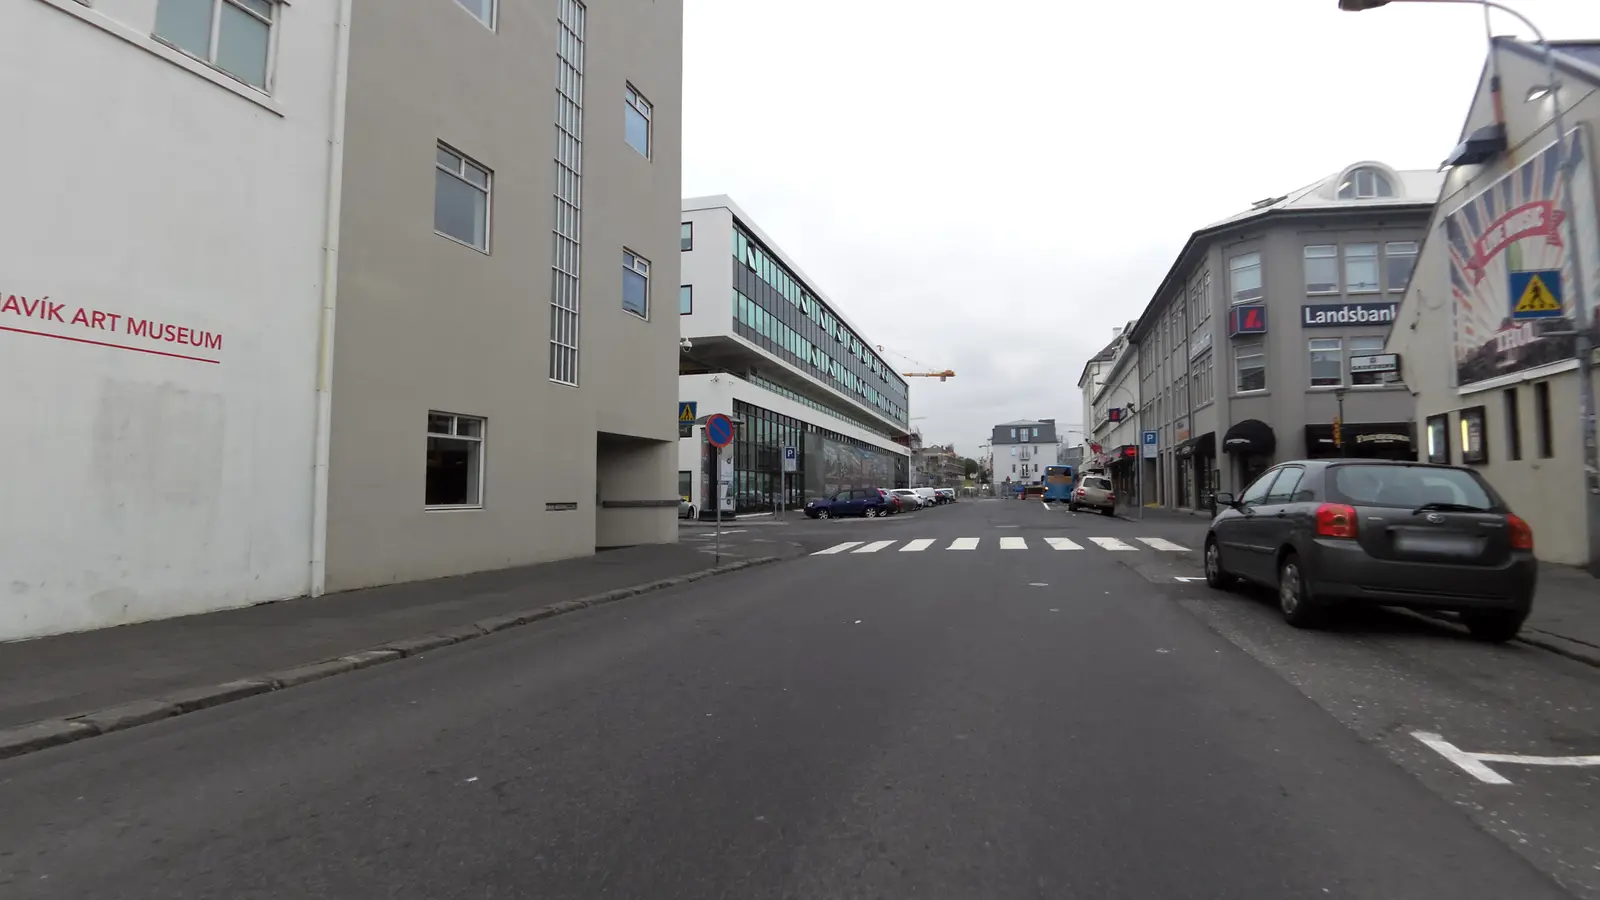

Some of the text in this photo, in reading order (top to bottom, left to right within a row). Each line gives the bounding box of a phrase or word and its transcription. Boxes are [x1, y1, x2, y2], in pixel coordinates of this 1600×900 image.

[0, 292, 222, 350] AVÍK ART MUSEUM
[1147, 434, 1154, 444] P
[787, 450, 793, 458] P
